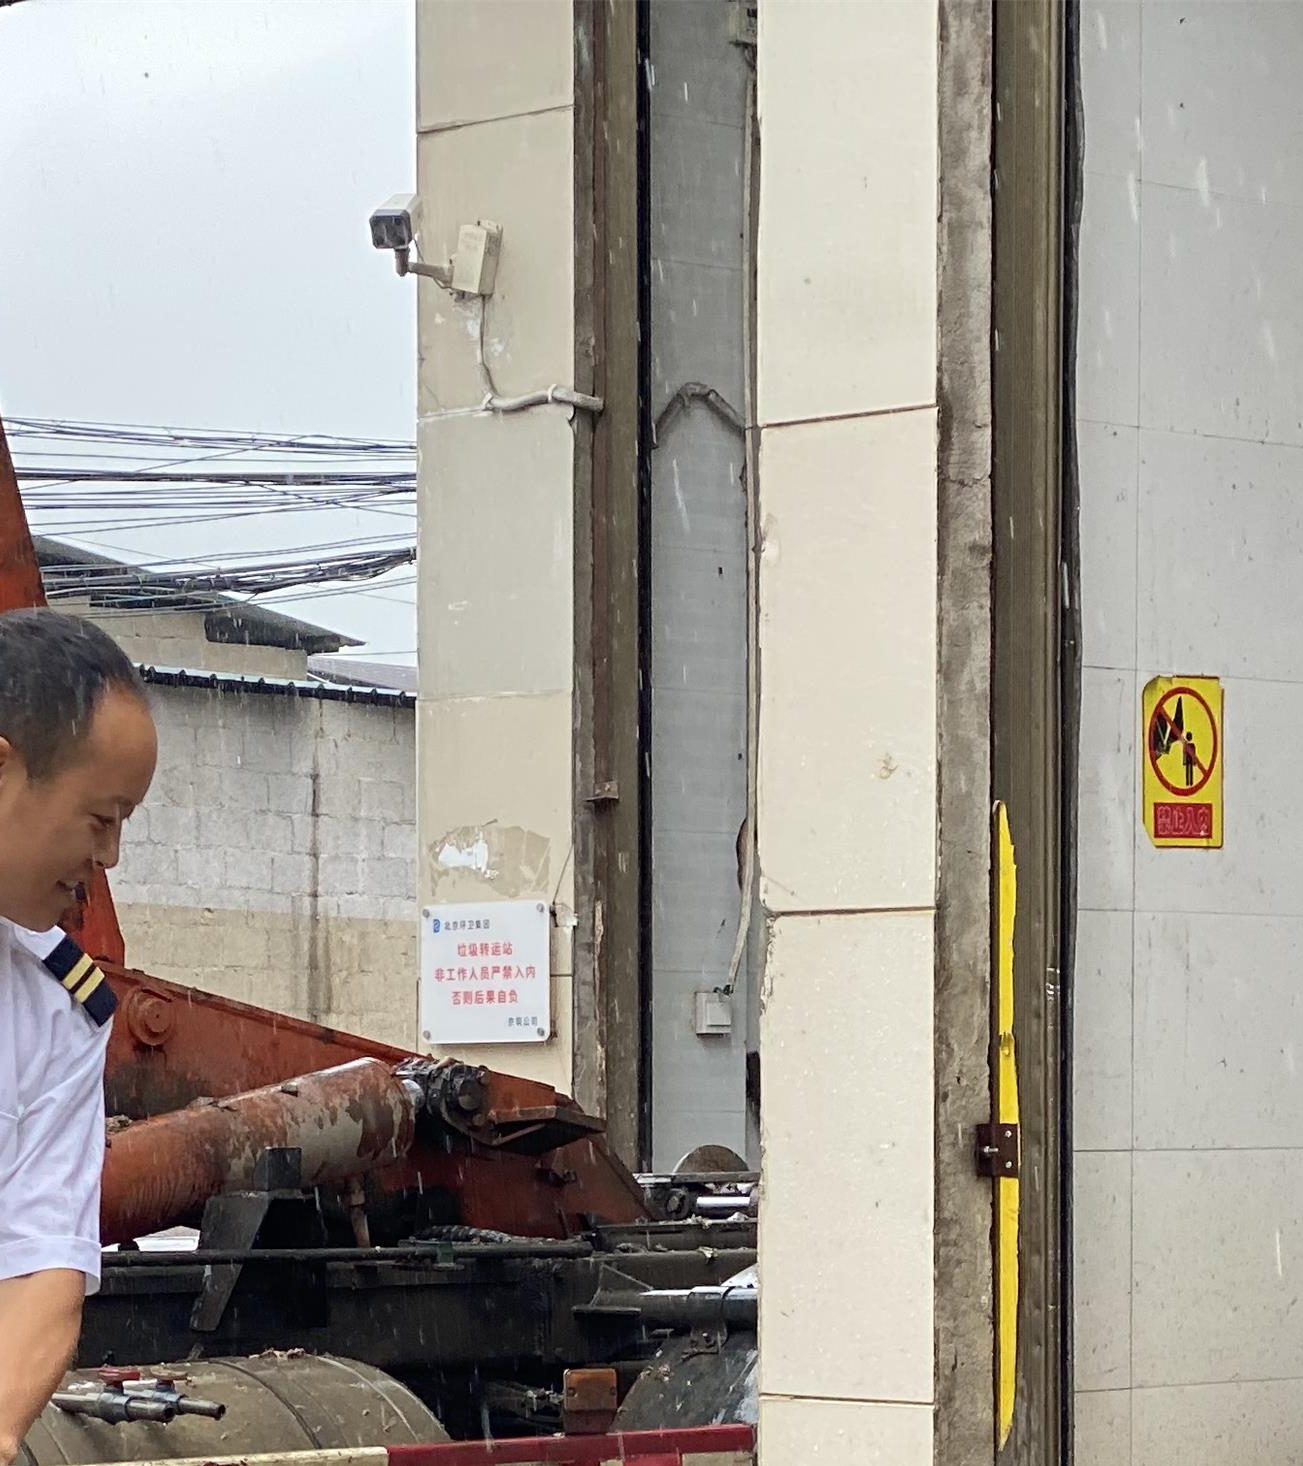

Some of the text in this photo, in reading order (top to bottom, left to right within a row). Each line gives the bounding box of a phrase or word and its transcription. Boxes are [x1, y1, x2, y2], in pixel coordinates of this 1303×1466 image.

[444, 919, 490, 930] 北京环卫集团
[457, 942, 513, 957] 垃圾转运站
[435, 966, 536, 981] 非工作人员严禁入内
[452, 990, 518, 1005] 否则后果自负
